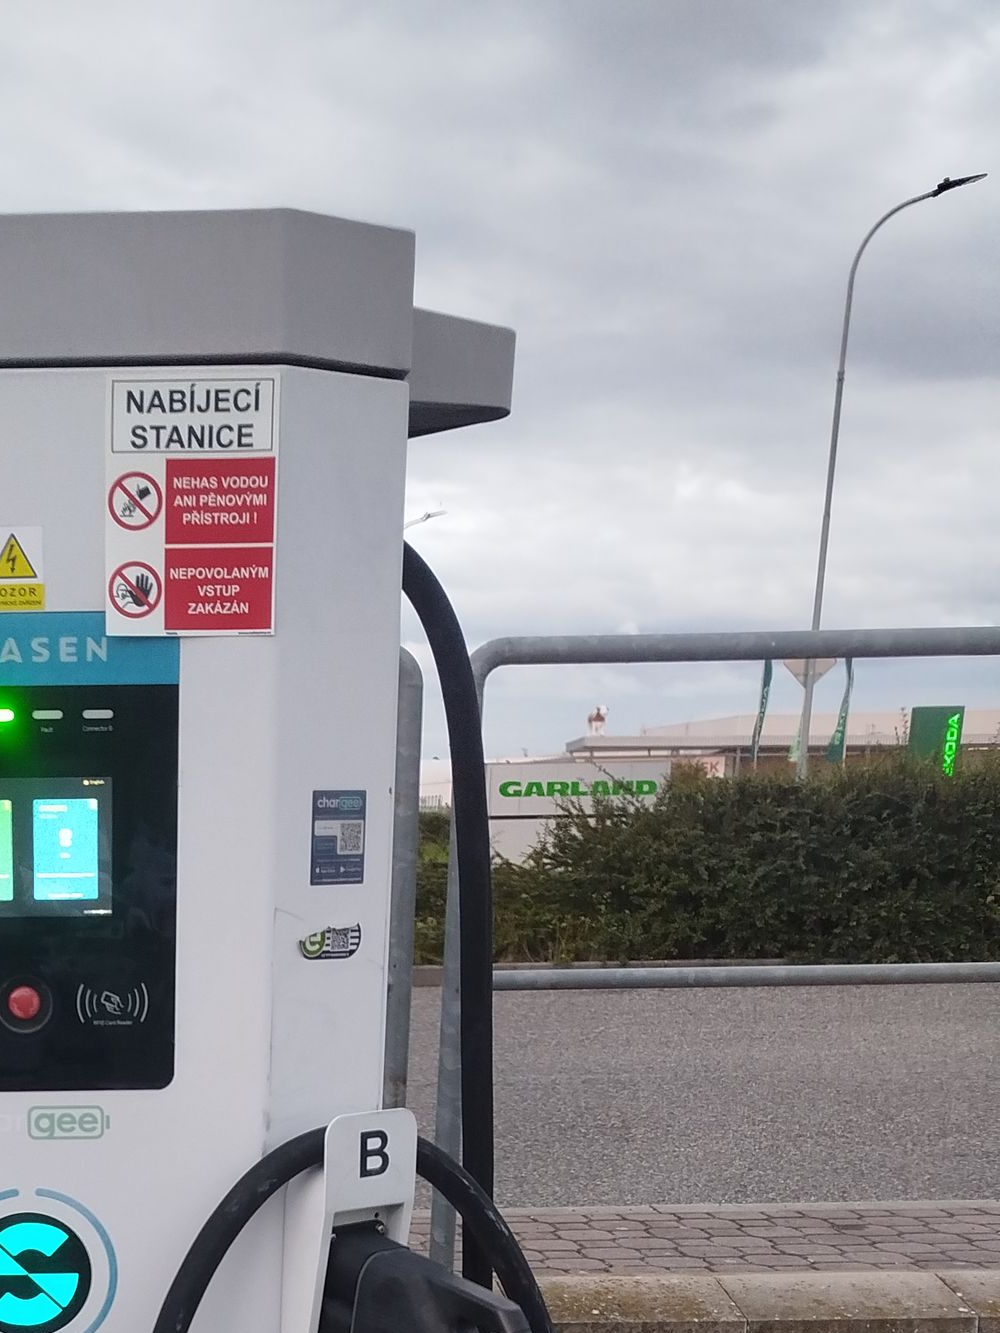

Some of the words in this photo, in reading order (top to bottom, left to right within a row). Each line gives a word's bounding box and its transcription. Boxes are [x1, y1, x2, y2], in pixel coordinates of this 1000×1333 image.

[126, 383, 261, 414] NABÍJECÍ
[130, 424, 254, 449] STANICE
[173, 476, 218, 489] NEHAS
[221, 475, 269, 488] VODOU
[173, 494, 196, 507] ANI
[199, 491, 268, 507] PĚNOVÝMI
[183, 509, 250, 525] PŘÍSTROJI
[170, 564, 269, 580] NEPOVOLANÝM
[197, 584, 240, 597] VSTUP
[187, 599, 249, 614] ZAKÁZÁN
[359, 1129, 390, 1178] B
